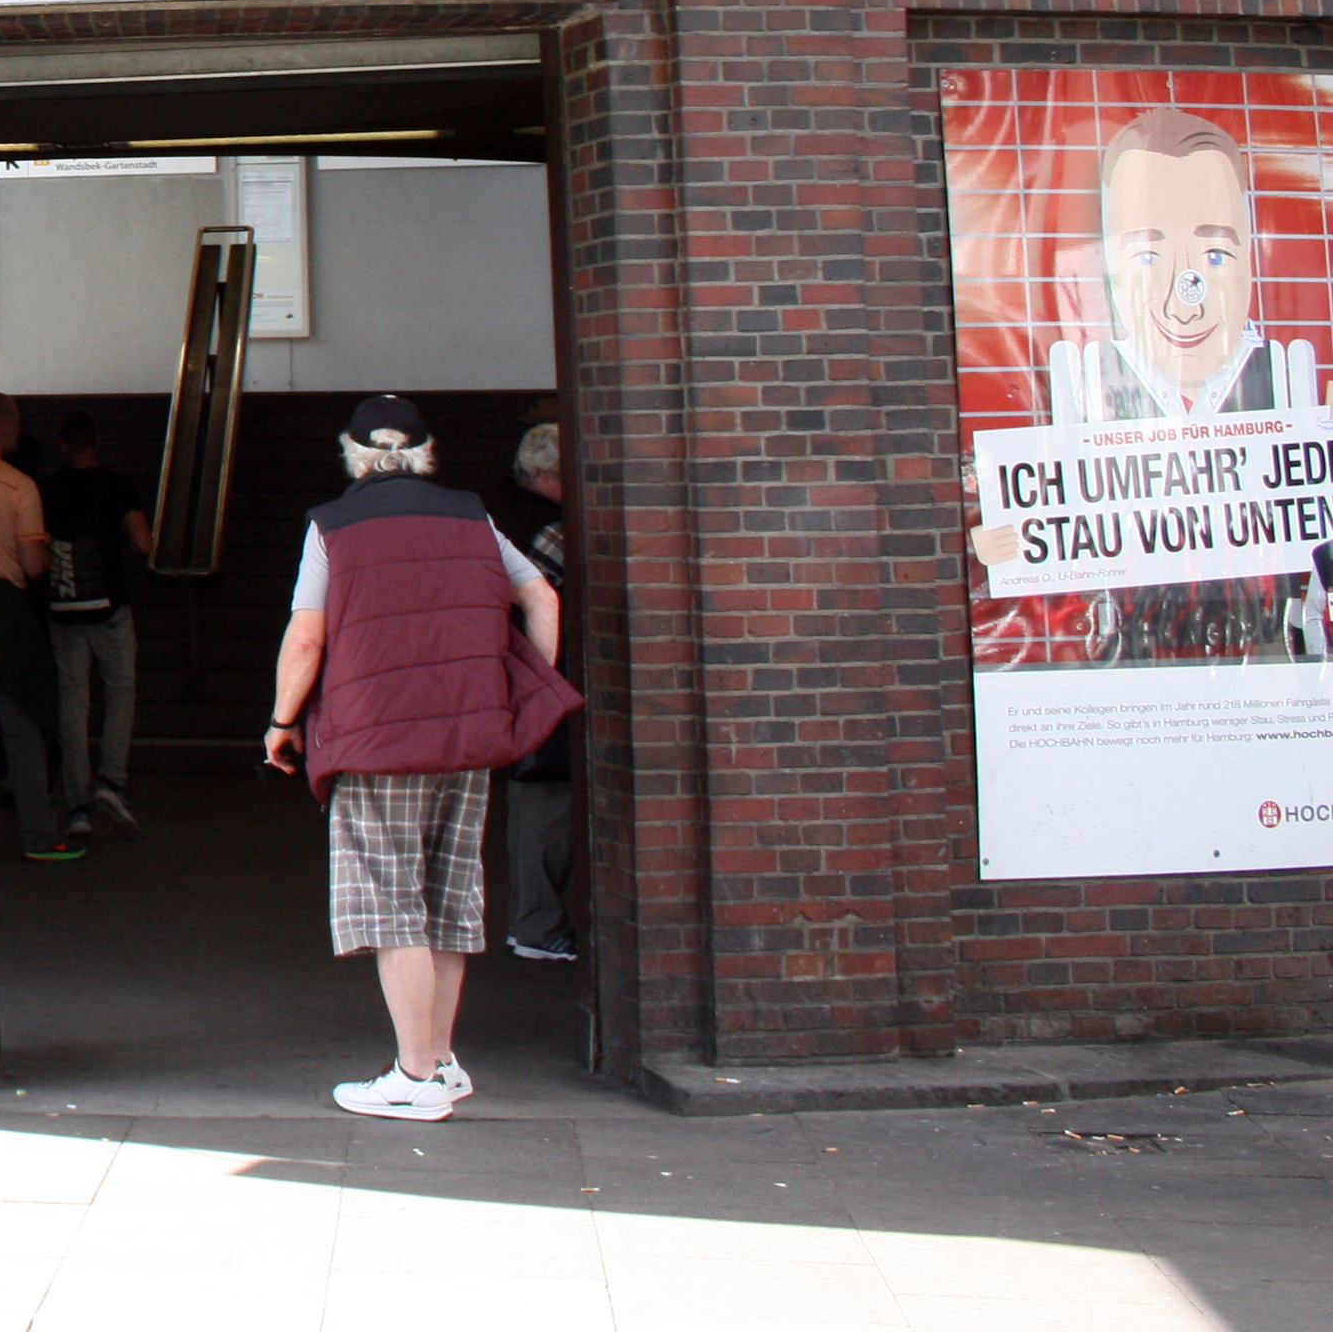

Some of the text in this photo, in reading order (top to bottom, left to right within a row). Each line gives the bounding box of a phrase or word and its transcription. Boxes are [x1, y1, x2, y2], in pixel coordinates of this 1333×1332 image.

[1149, 430, 1177, 444] JOB
[1182, 423, 1210, 440] FÜR
[998, 461, 1066, 509] ICH
[1262, 440, 1333, 489] JED
[1022, 512, 1123, 564] STAU
[1134, 505, 1214, 553] VON
[1008, 707, 1019, 716] Er
[1022, 706, 1041, 716] und
[1045, 706, 1071, 715] seine
[1074, 704, 1117, 715] Kollegen
[1120, 703, 1157, 714] bringen
[1174, 701, 1195, 711] Jahr
[1199, 701, 1221, 710] rund
[1243, 699, 1283, 709] Millionen
[1009, 722, 1037, 732] direkt
[1056, 721, 1074, 731] ihre
[1107, 720, 1120, 729] So
[1153, 719, 1160, 728] in
[1164, 717, 1209, 728] Hamburg
[1212, 716, 1248, 727] weniger
[1277, 714, 1306, 724] Stress
[1308, 713, 1326, 722] und
[1009, 739, 1026, 749] Die
[1029, 737, 1094, 748] HOCHBAHN
[1097, 736, 1134, 747] bewegt
[1136, 735, 1161, 744] noch
[1164, 733, 1188, 743] mehr
